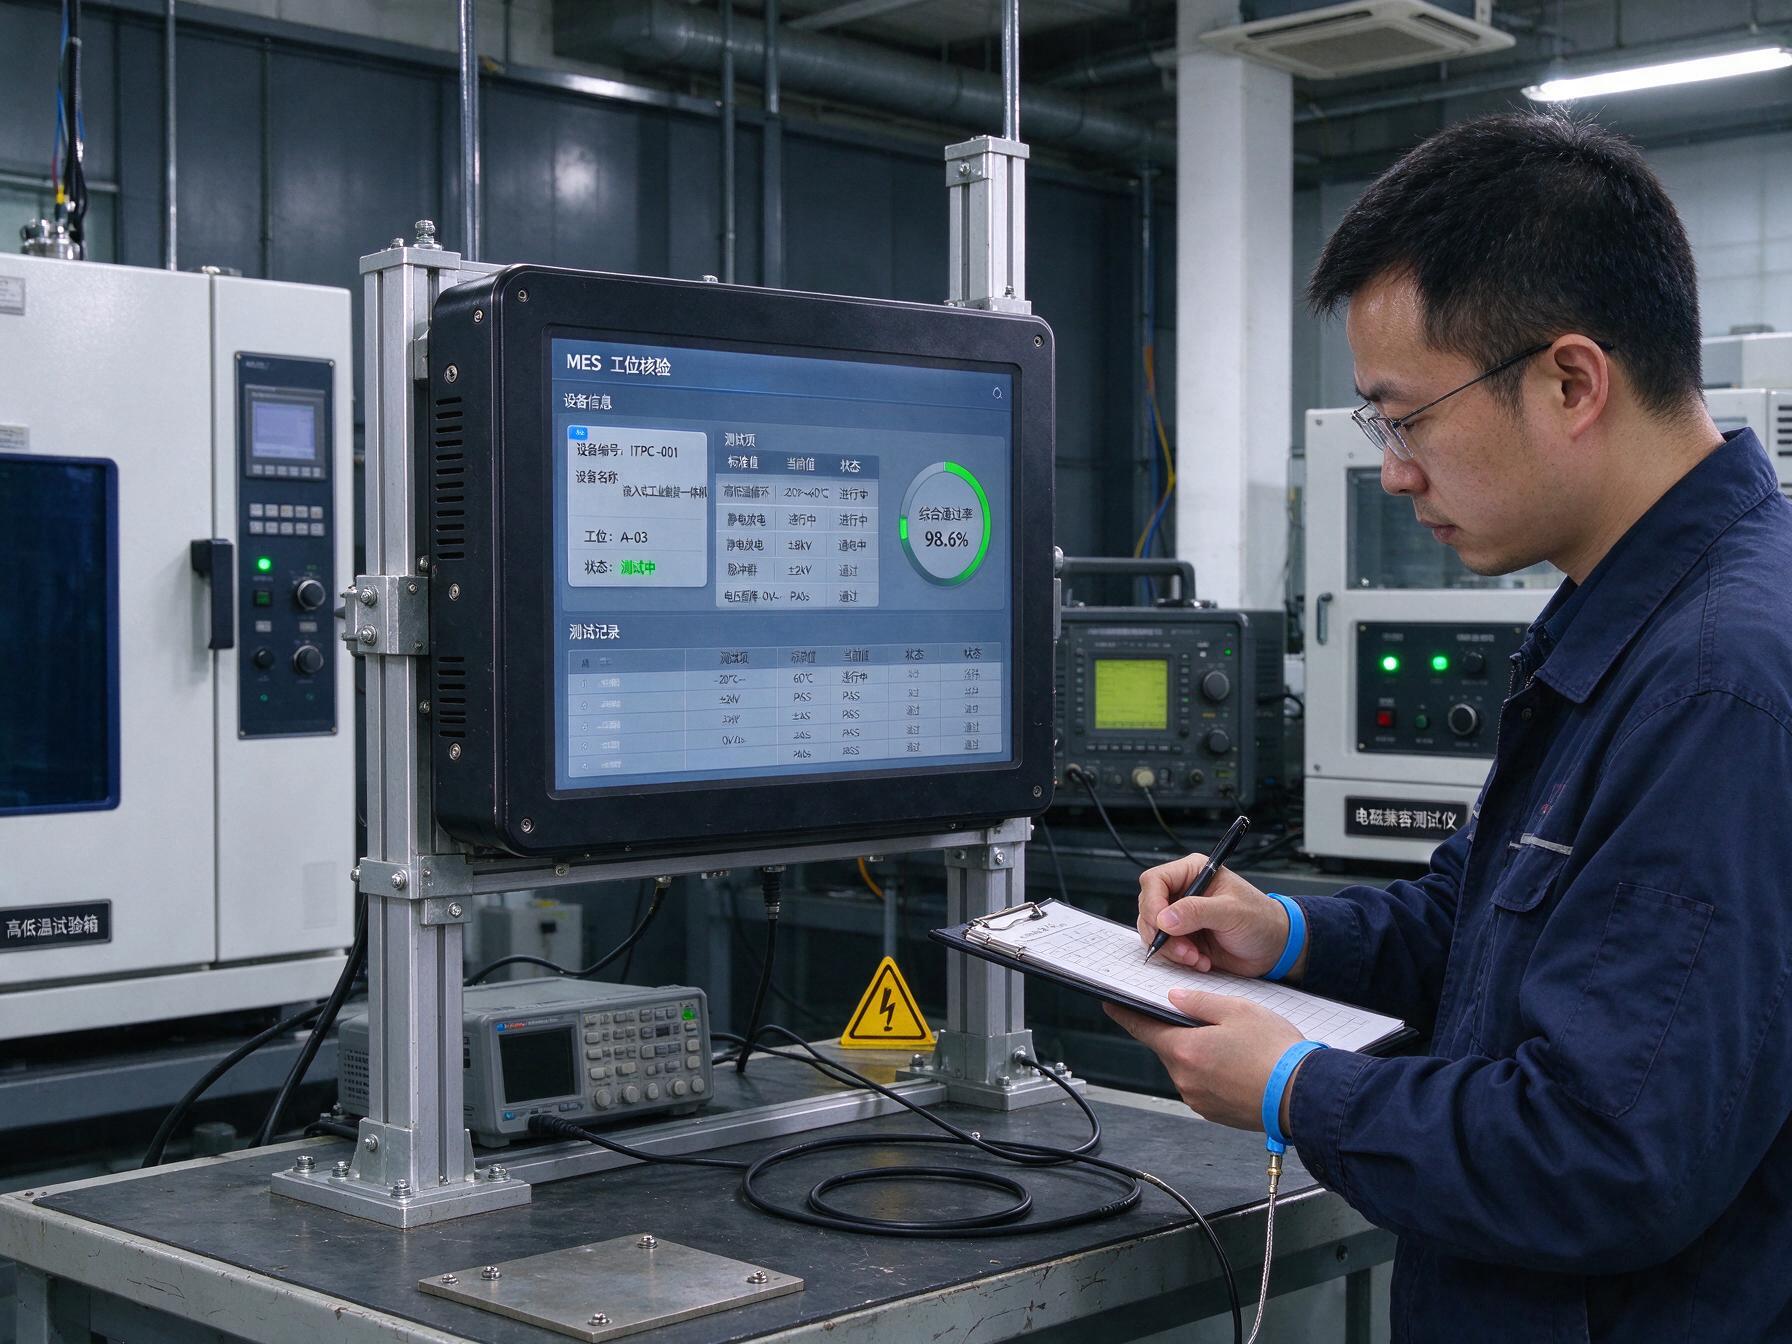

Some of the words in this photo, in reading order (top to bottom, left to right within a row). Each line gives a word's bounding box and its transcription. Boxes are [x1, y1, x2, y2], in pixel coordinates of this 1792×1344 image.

[566, 353, 601, 371] MES
[610, 356, 672, 376] 工位核验
[563, 393, 612, 410] 设备信息
[724, 433, 756, 447] 测试项
[630, 445, 678, 458] ITPC-001
[840, 459, 861, 473] 状态
[918, 506, 974, 522] 综合通过率
[621, 531, 649, 544] A-03
[925, 531, 969, 548] 98.6%
[621, 560, 656, 575] 测试中
[568, 623, 621, 640] 测试记录
[5, 914, 99, 939] 高低温试验箱
